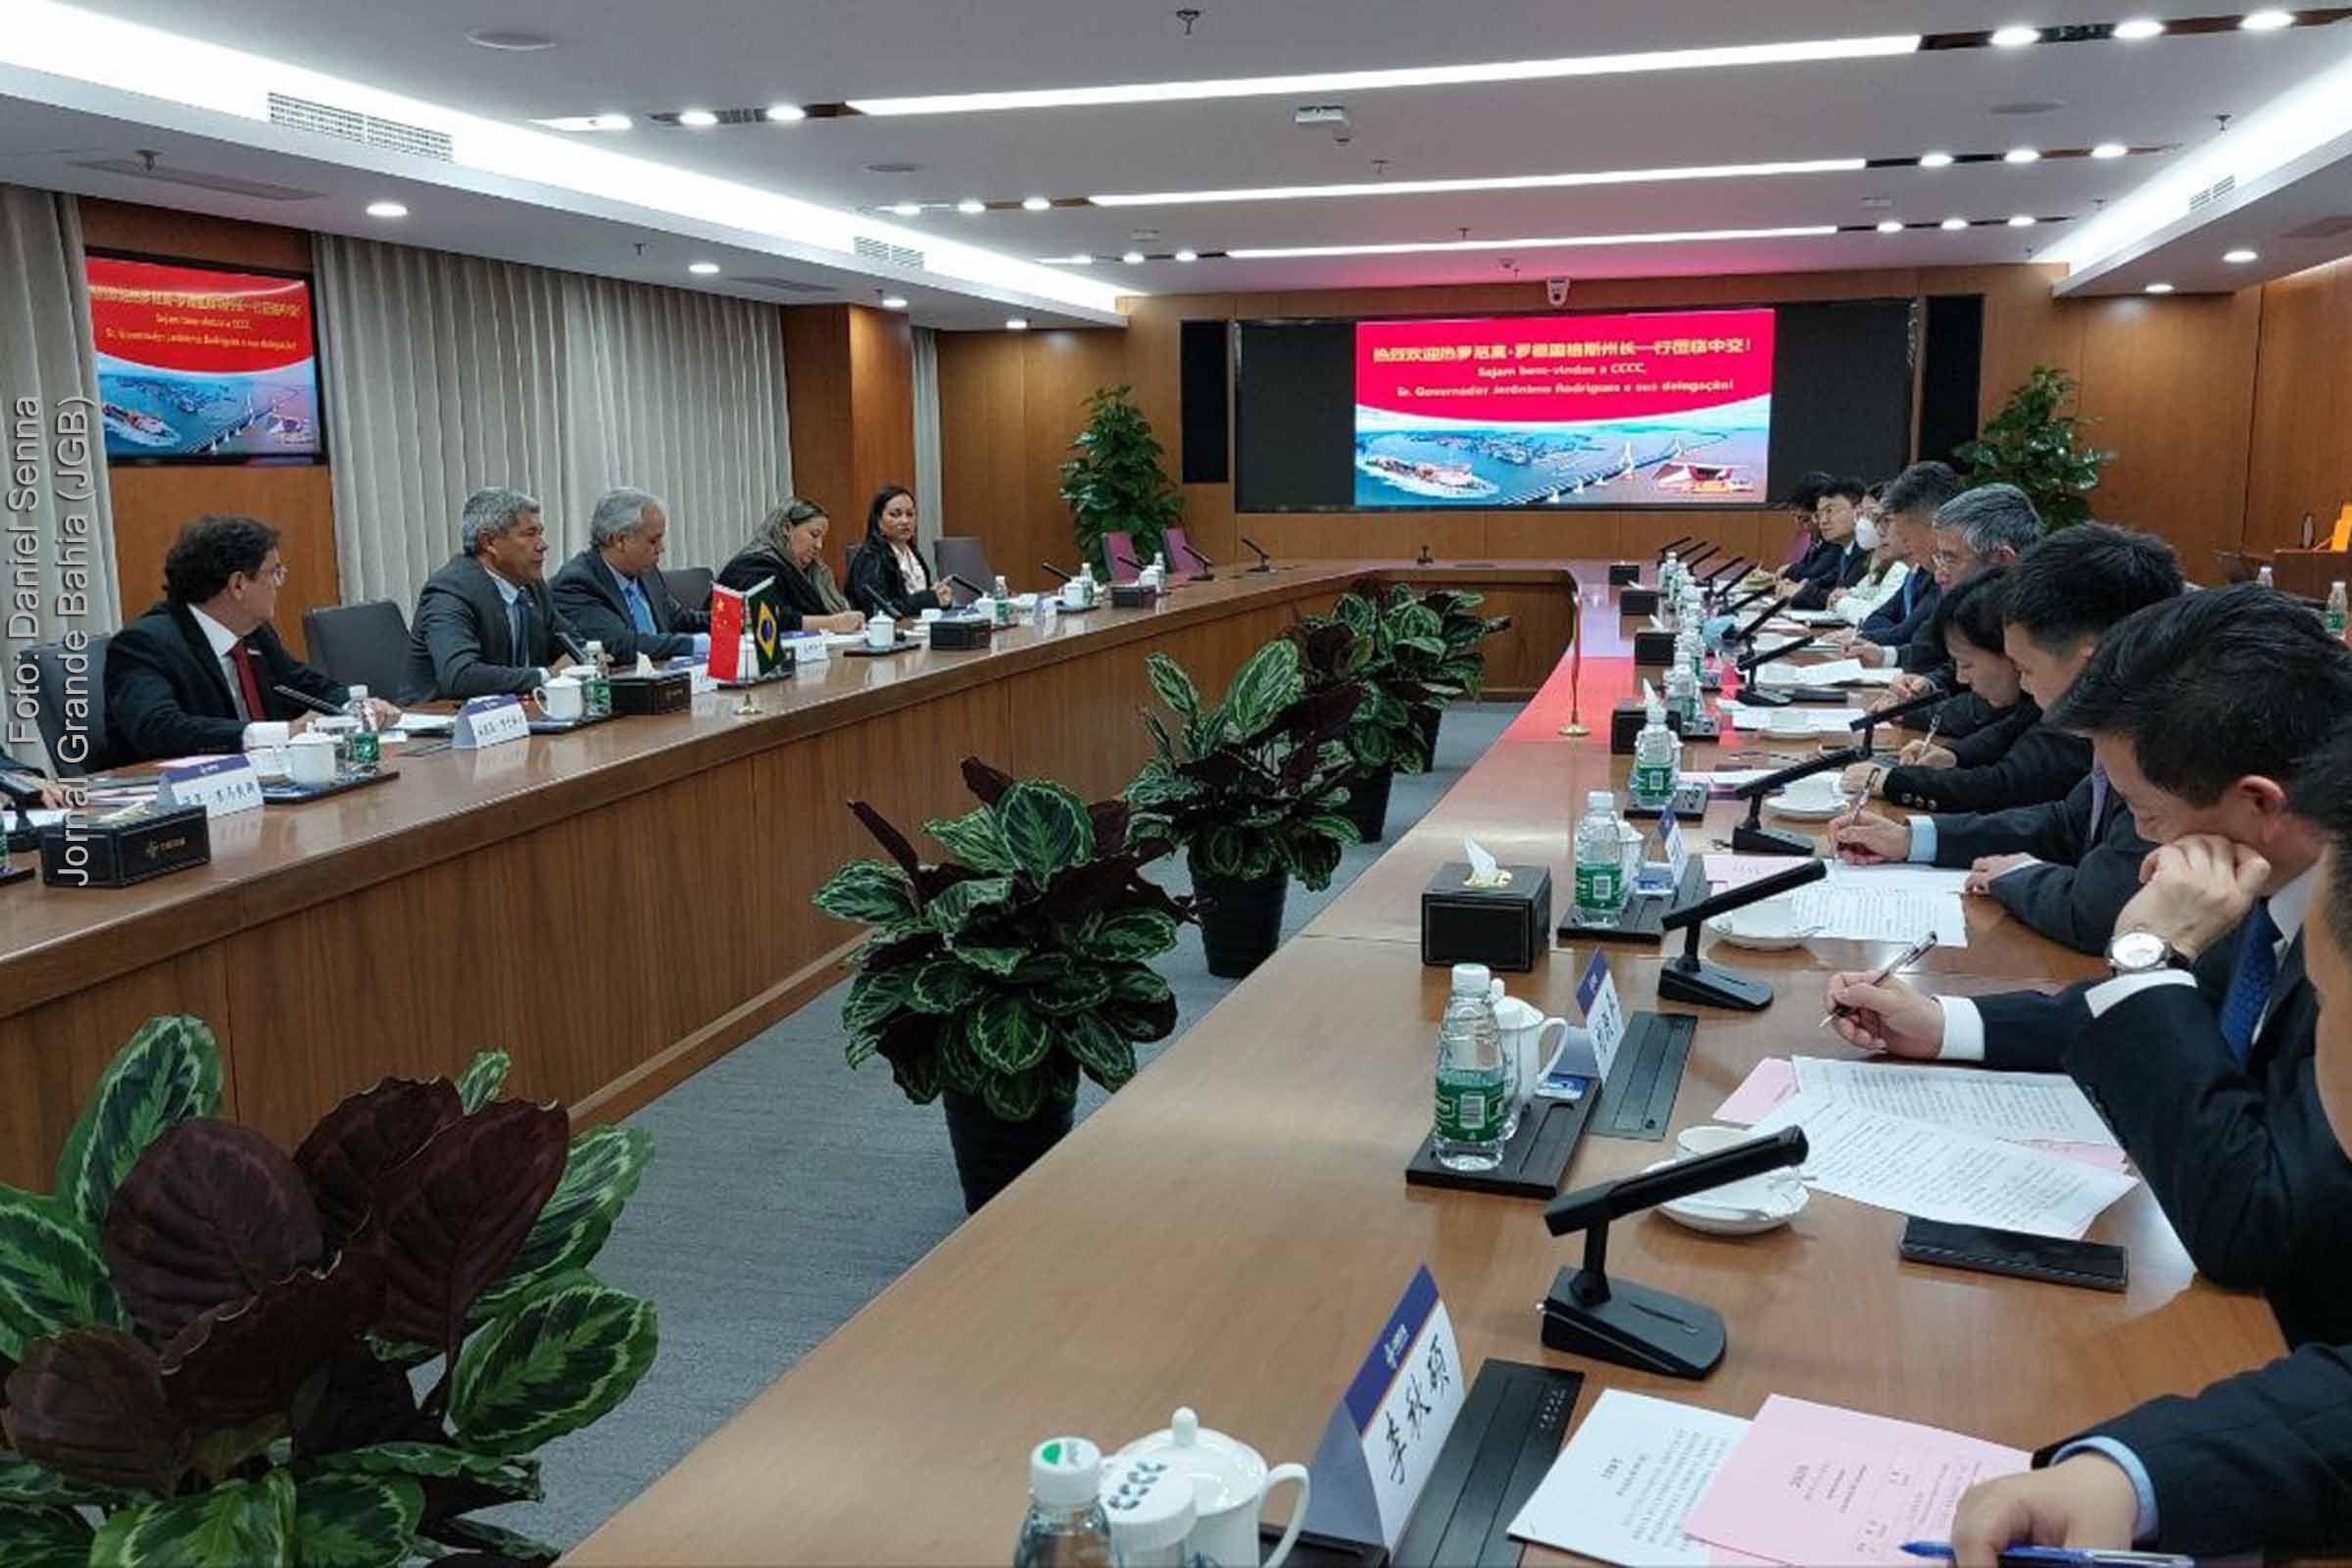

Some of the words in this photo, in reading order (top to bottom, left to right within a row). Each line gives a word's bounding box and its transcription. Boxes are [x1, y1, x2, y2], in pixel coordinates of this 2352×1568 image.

[1478, 366, 1515, 379] Sejam
[1414, 385, 1489, 398] Governador
[1555, 381, 1621, 395] Rodrigues
